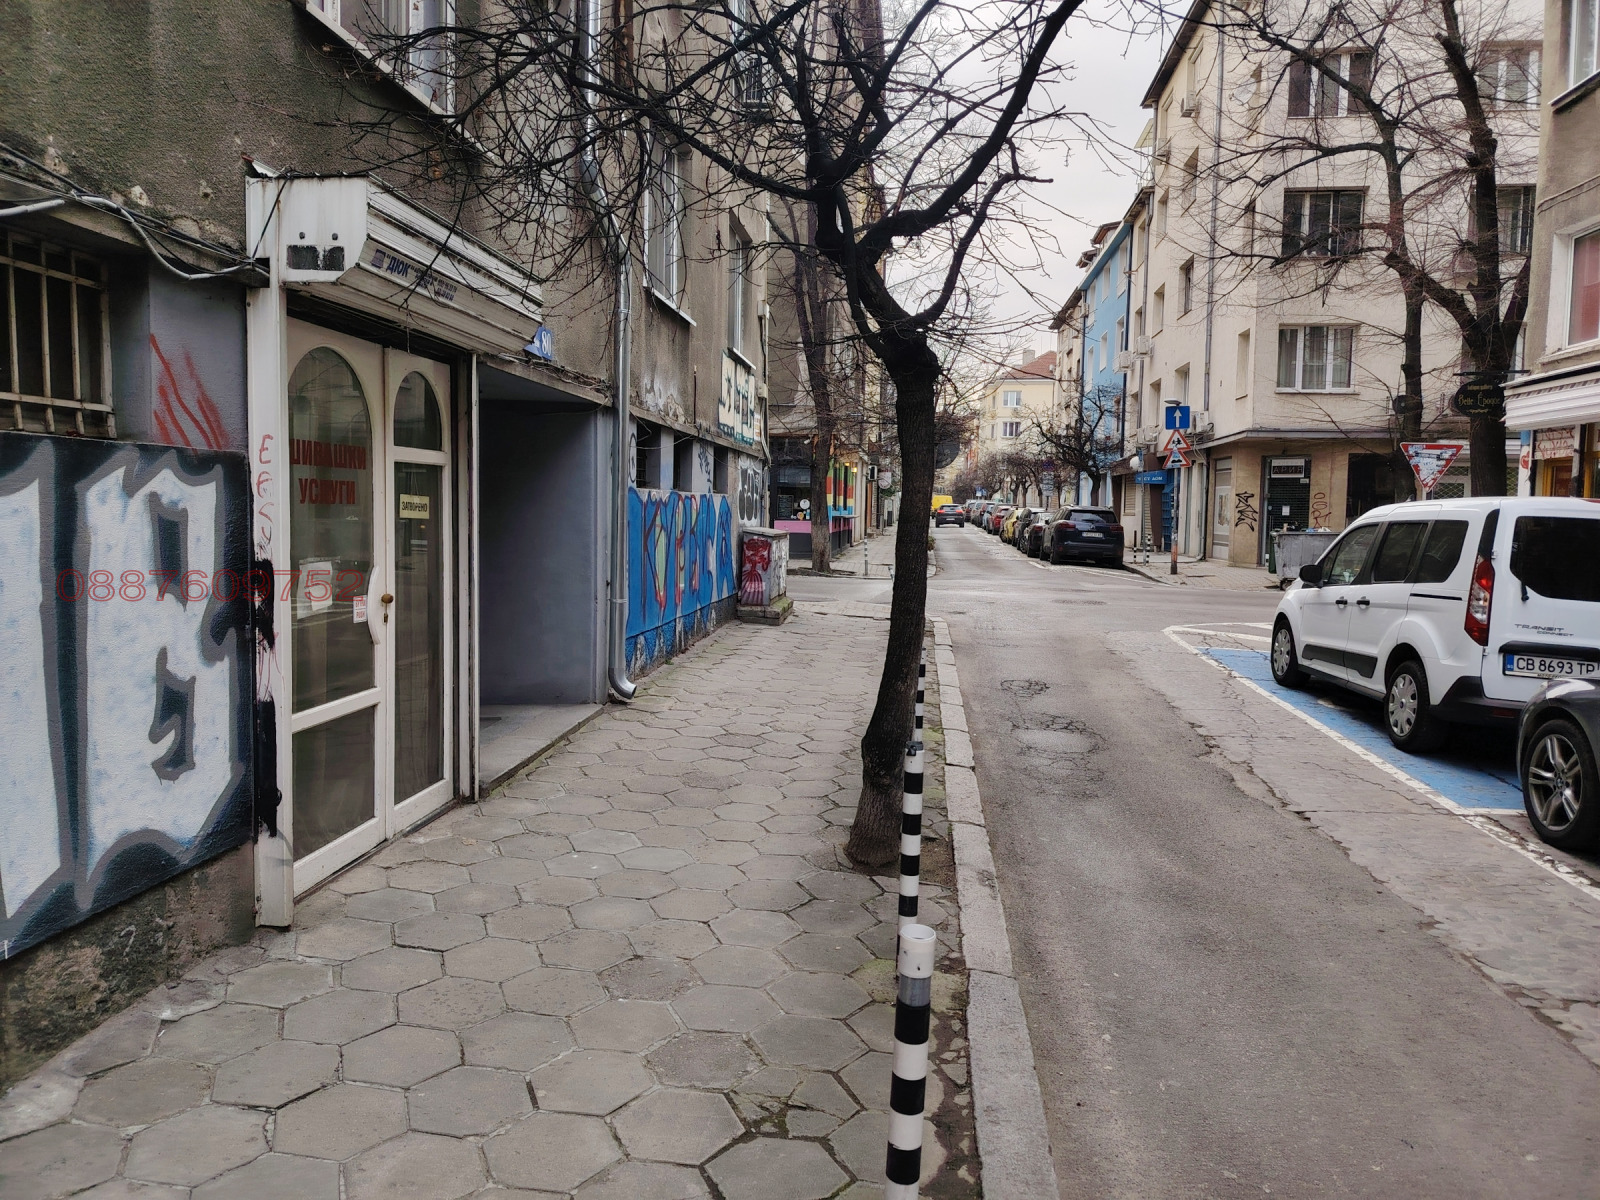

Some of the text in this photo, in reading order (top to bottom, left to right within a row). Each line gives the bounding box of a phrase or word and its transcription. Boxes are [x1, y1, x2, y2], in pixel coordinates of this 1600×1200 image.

[541, 331, 552, 356] 80
[289, 438, 367, 470] ШИВАШКИ
[1273, 466, 1303, 474] АРИЯ
[298, 477, 356, 505] УСЛУГИ
[401, 501, 428, 513] ЗАТВОРЕНО
[1514, 623, 1565, 632] TRANSIT
[1516, 657, 1595, 675] CB 8693 TP
